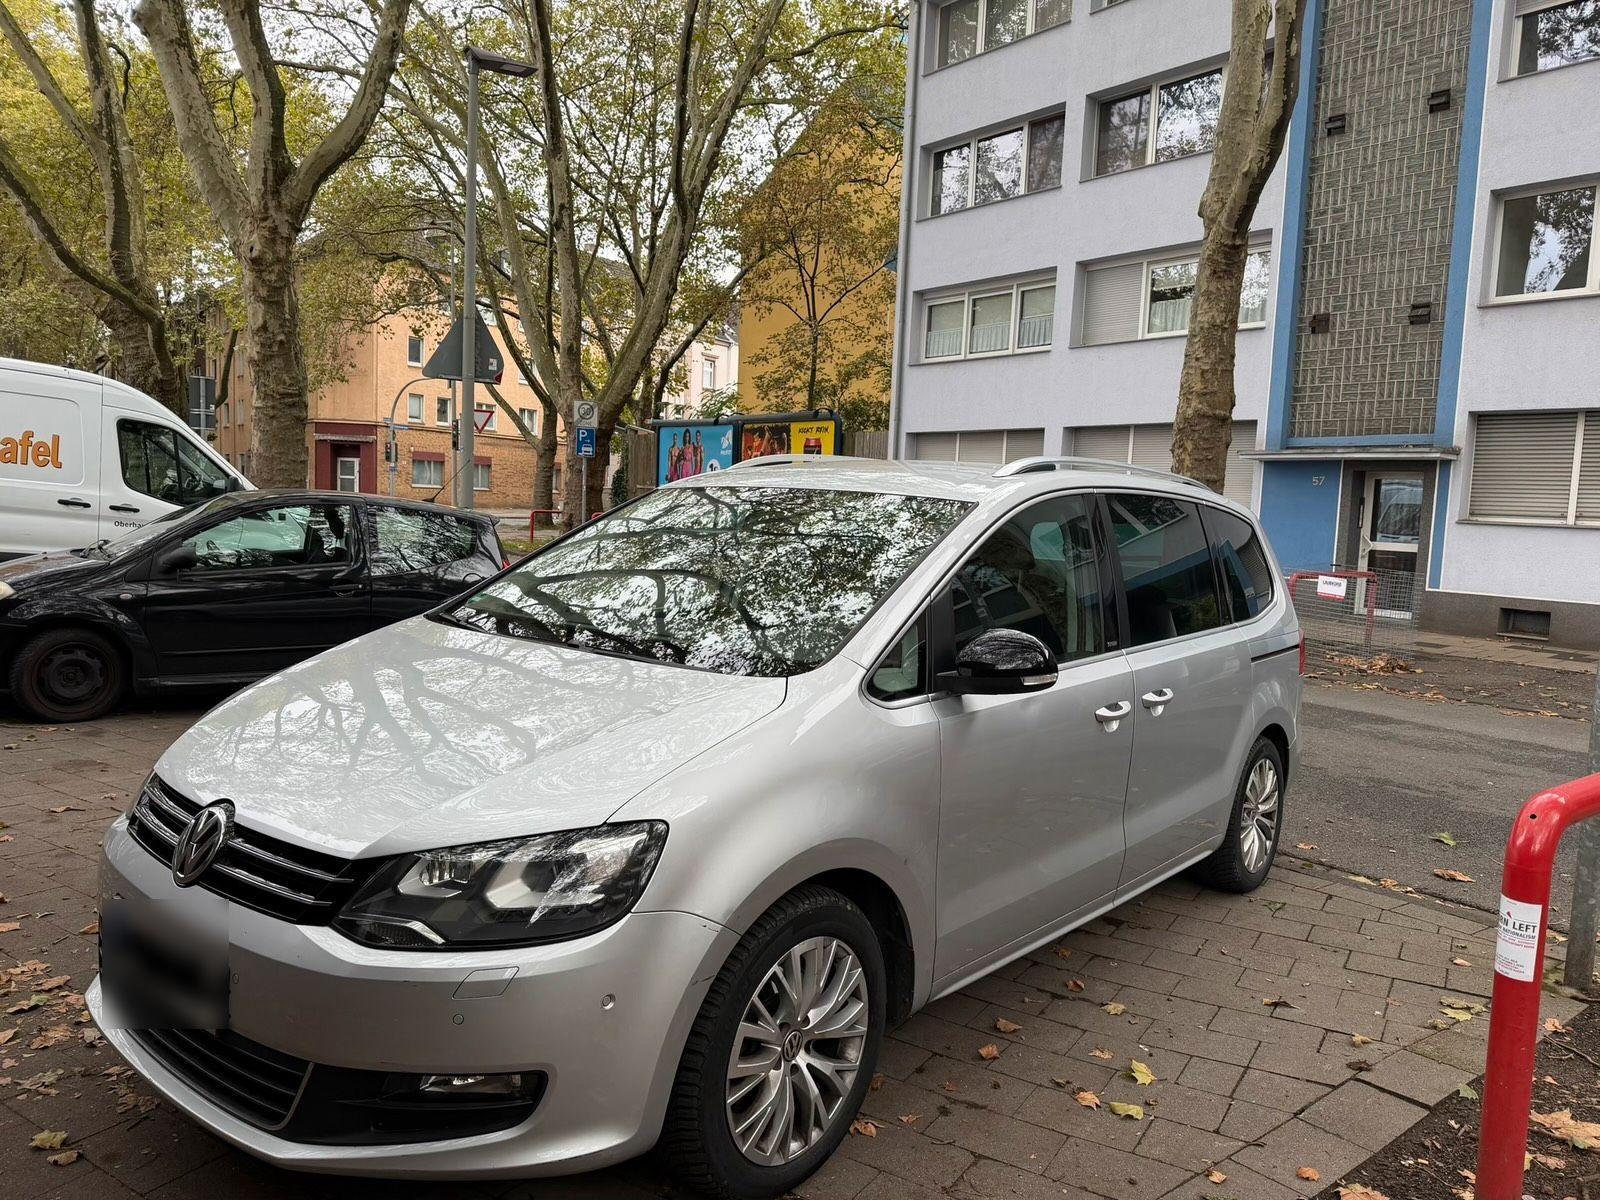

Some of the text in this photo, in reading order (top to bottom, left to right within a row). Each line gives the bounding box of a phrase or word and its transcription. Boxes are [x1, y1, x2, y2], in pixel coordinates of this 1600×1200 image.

[581, 407, 591, 416] 30
[579, 429, 588, 442] P
[1312, 476, 1325, 486] 57
[114, 520, 144, 529] Oberha
[1512, 921, 1537, 934] LEFT
[1502, 927, 1536, 940] NATIONALISM
